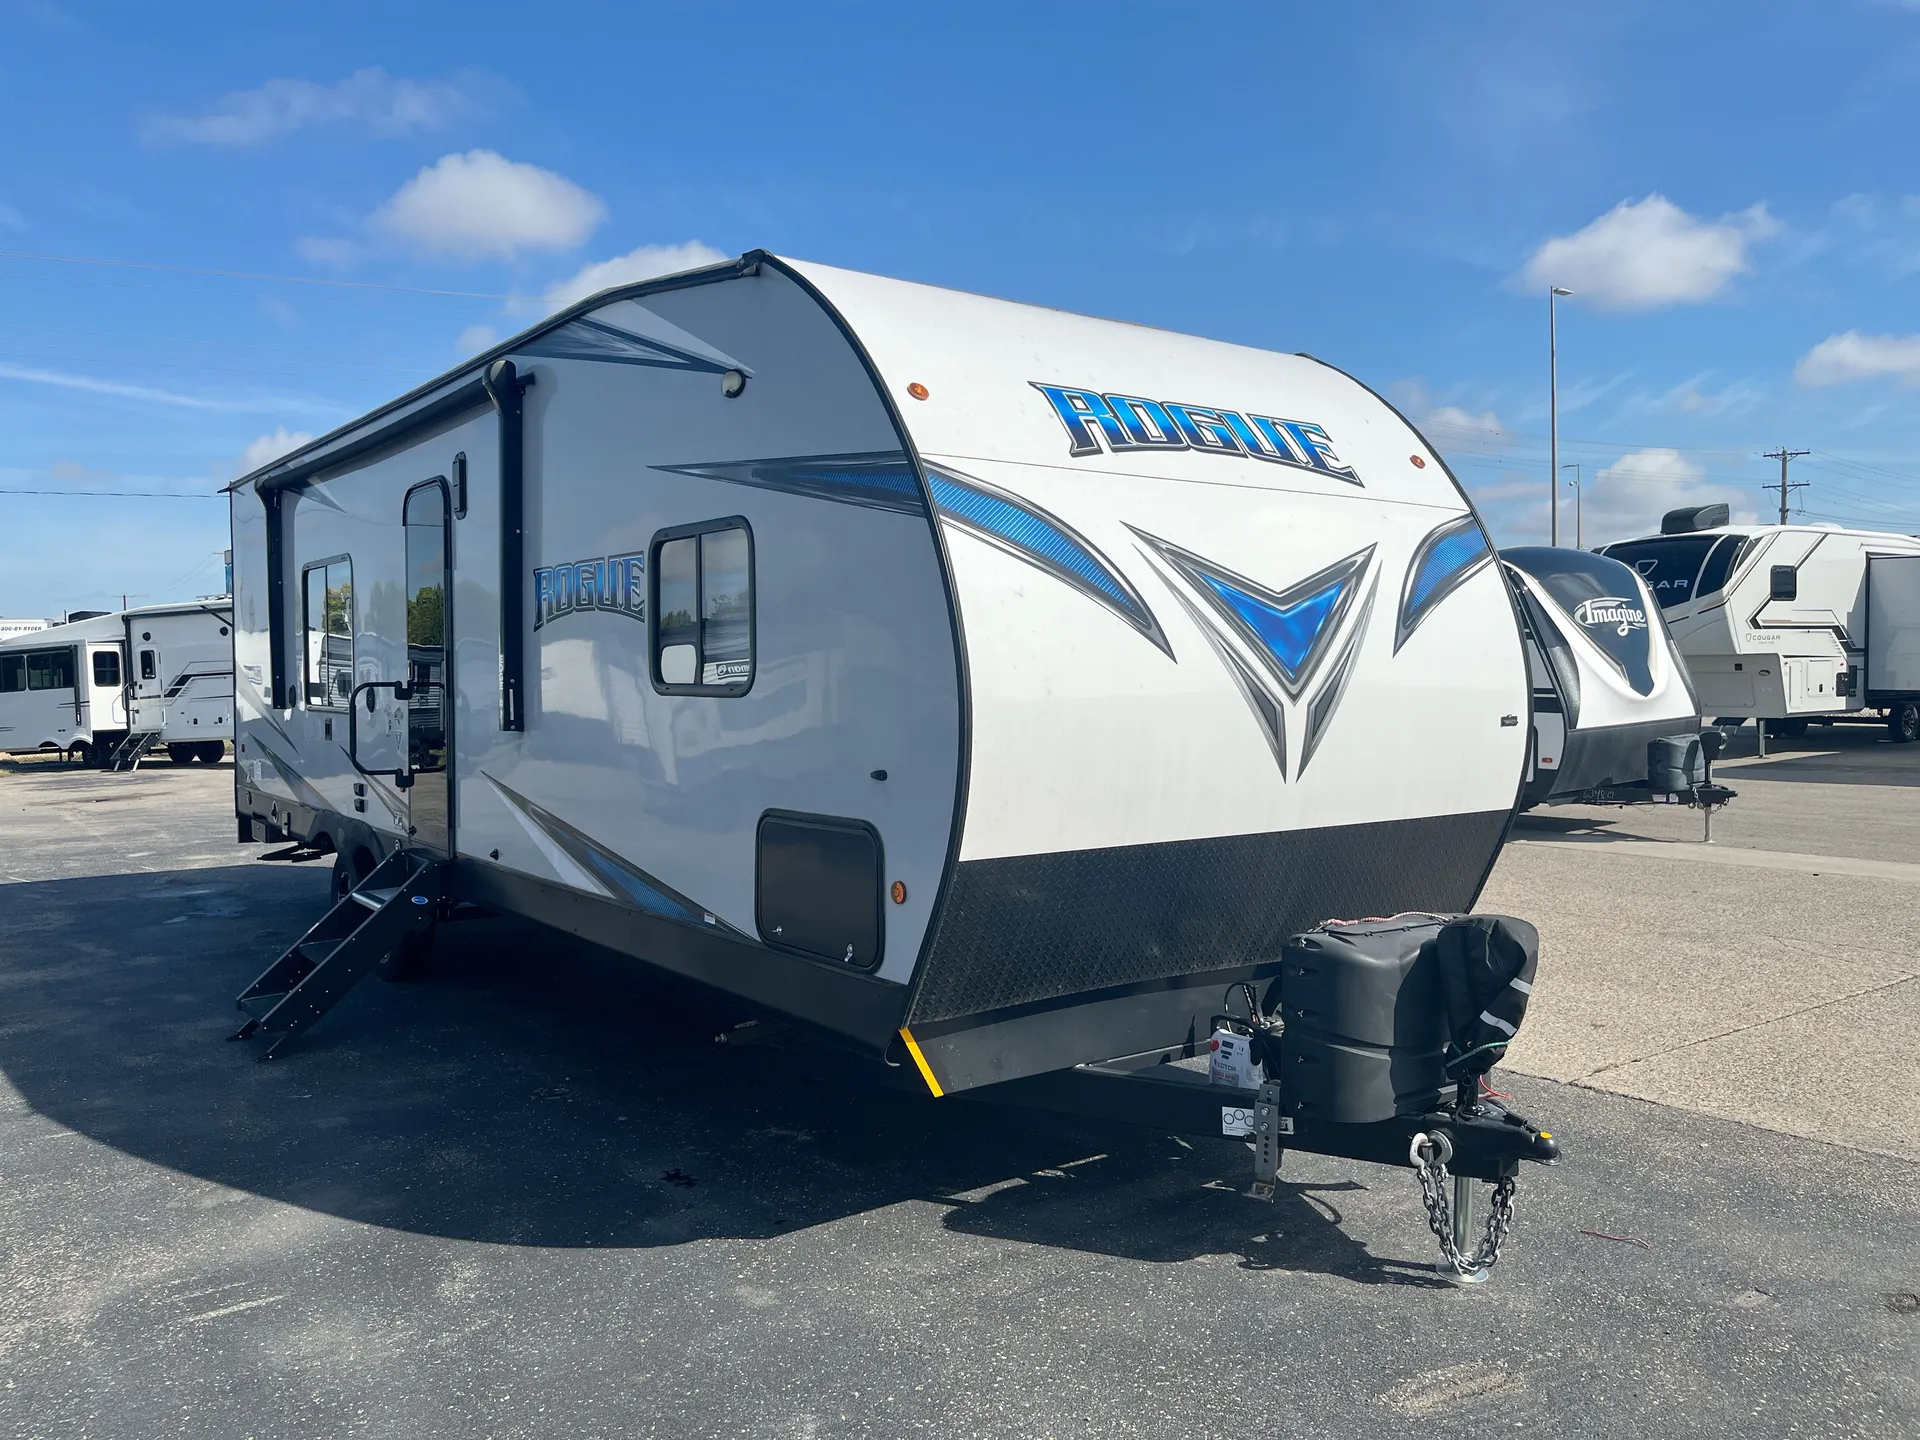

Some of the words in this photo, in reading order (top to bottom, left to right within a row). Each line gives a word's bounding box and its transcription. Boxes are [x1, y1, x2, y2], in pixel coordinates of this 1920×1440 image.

[1027, 381, 1365, 488] ROGUE
[533, 550, 645, 632] ROGUE
[1582, 599, 1645, 636] Imagine
